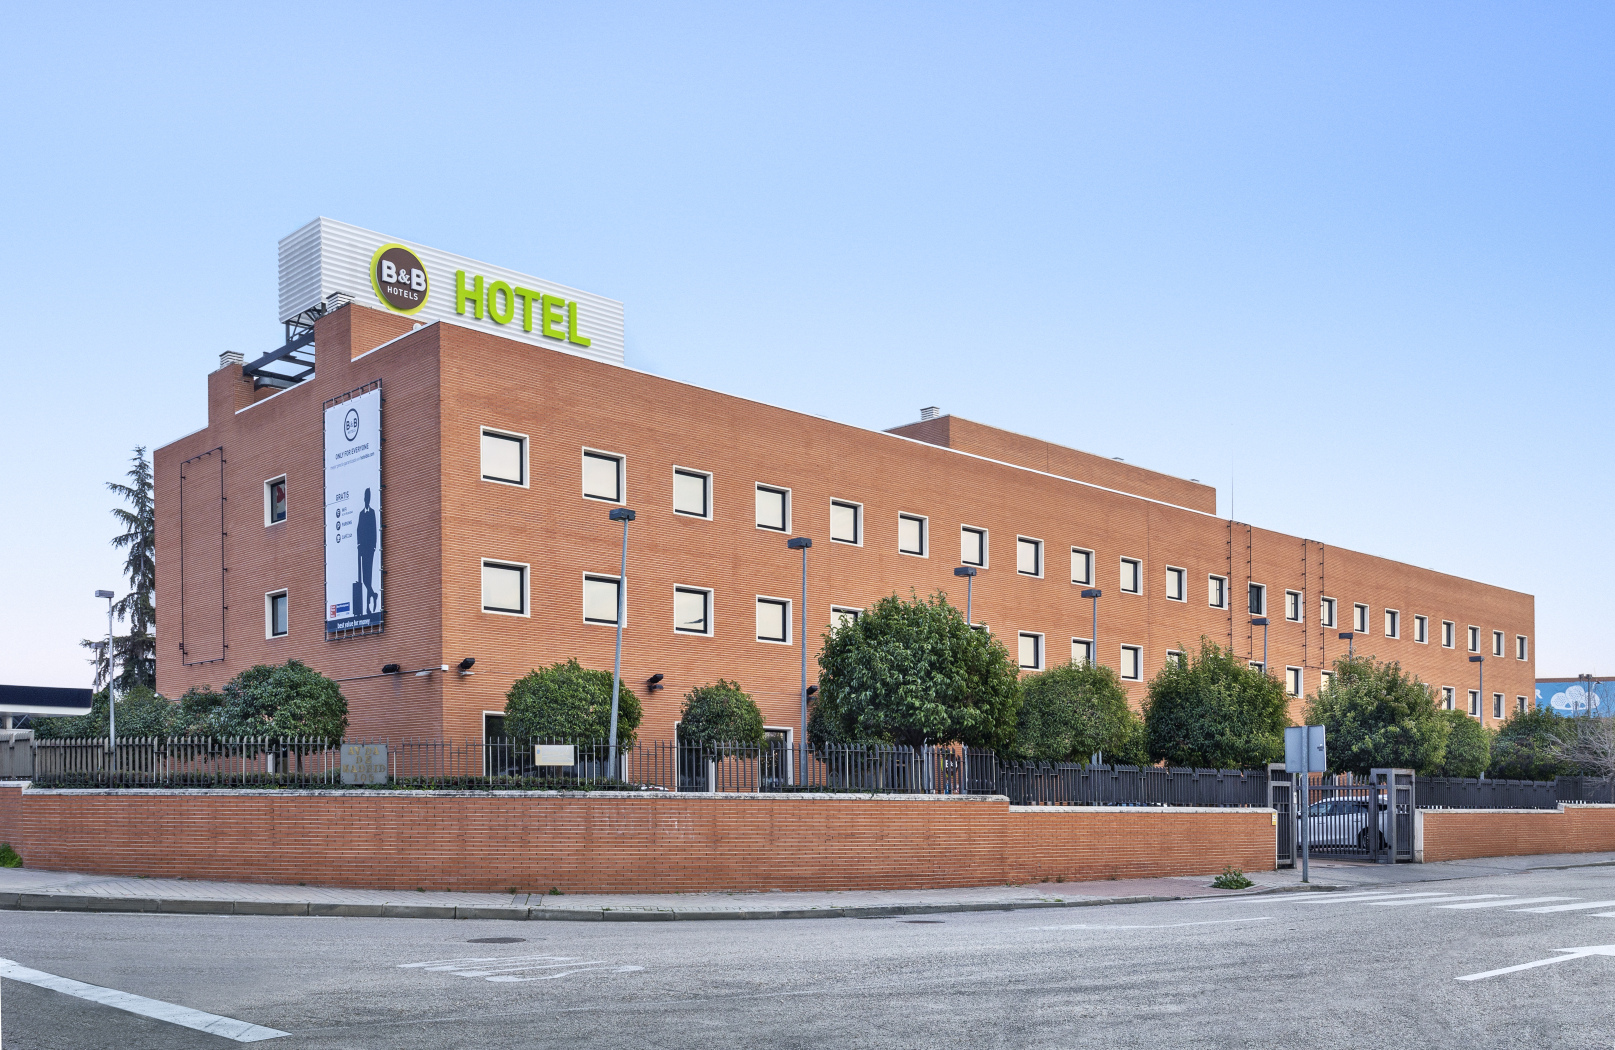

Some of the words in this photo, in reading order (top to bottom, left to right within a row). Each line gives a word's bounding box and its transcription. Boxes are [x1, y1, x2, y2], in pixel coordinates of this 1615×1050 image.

[381, 260, 427, 292] B&B
[387, 285, 419, 301] HOTELS
[456, 270, 591, 347] HOTEL
[346, 418, 357, 430] B&B
[356, 755, 372, 764] DE
[342, 764, 386, 773] MADRID
